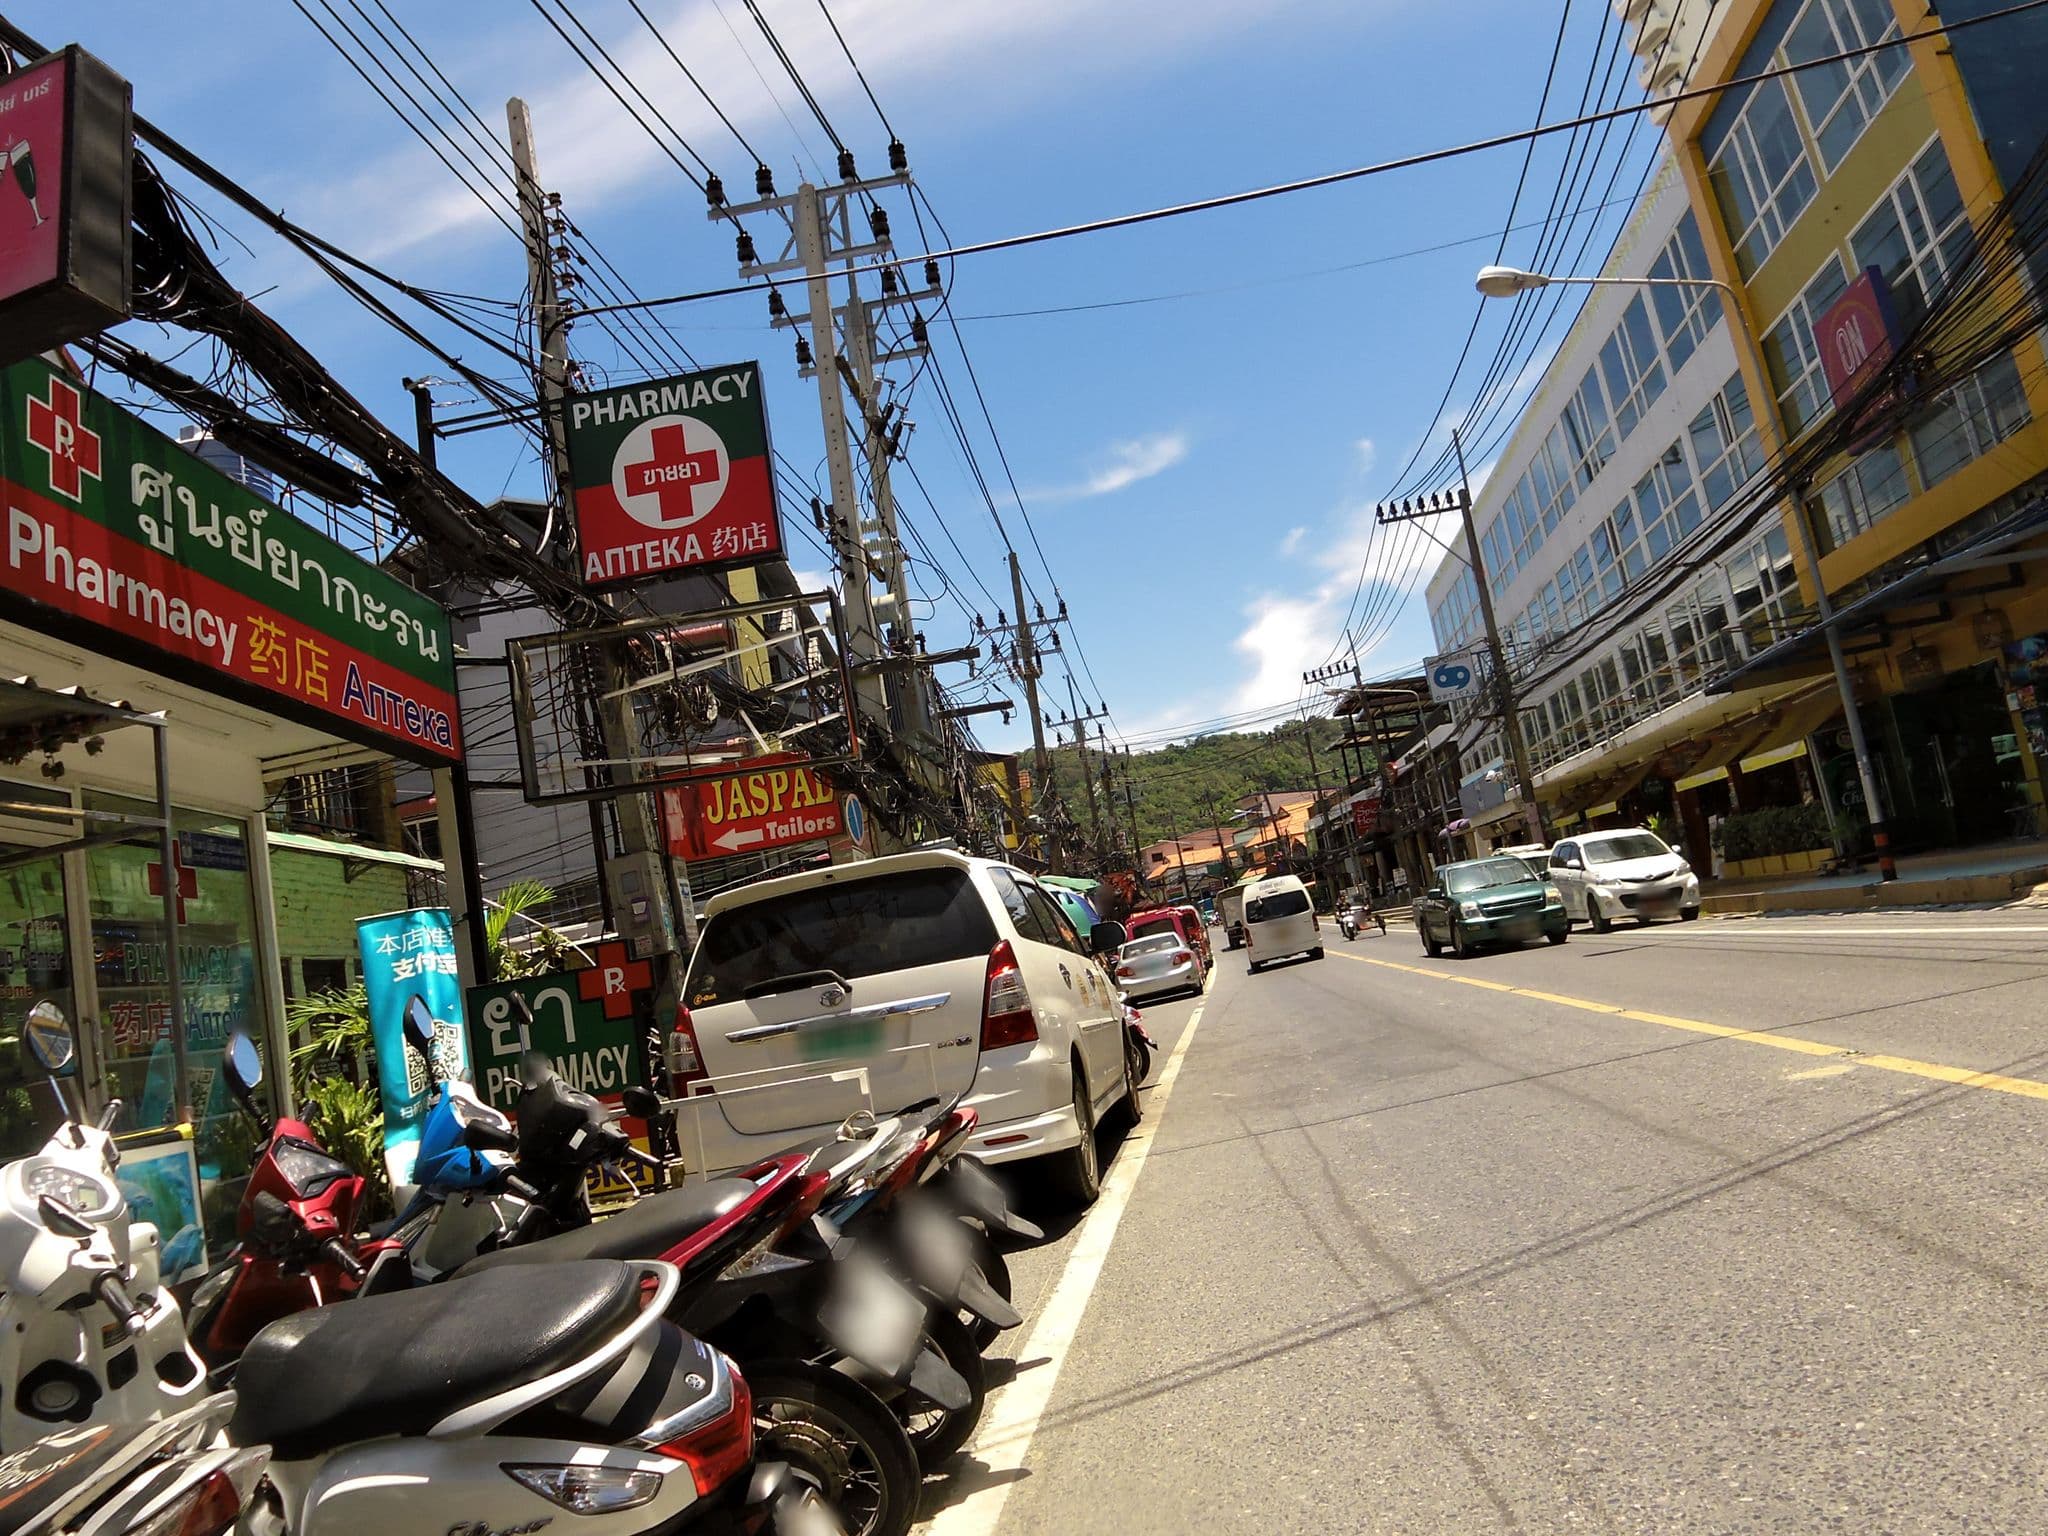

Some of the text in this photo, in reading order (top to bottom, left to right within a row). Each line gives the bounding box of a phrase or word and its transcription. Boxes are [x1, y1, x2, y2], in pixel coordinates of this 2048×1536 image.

[23, 77, 52, 102] บาร์
[573, 371, 752, 430] PHARMACY
[643, 462, 701, 486] ขายยา
[131, 463, 439, 662] ศูนย์ยากะรน
[584, 522, 768, 581] АПТЕКА 药店
[8, 506, 455, 751] Pharmacy 药店 Аптека
[1435, 688, 1481, 701] OPTICAL
[707, 768, 834, 824] JASPAL
[766, 815, 836, 840] Tailors
[124, 943, 234, 983] PHAMACY
[110, 999, 174, 1046] 药店
[482, 987, 576, 1057] ยา
